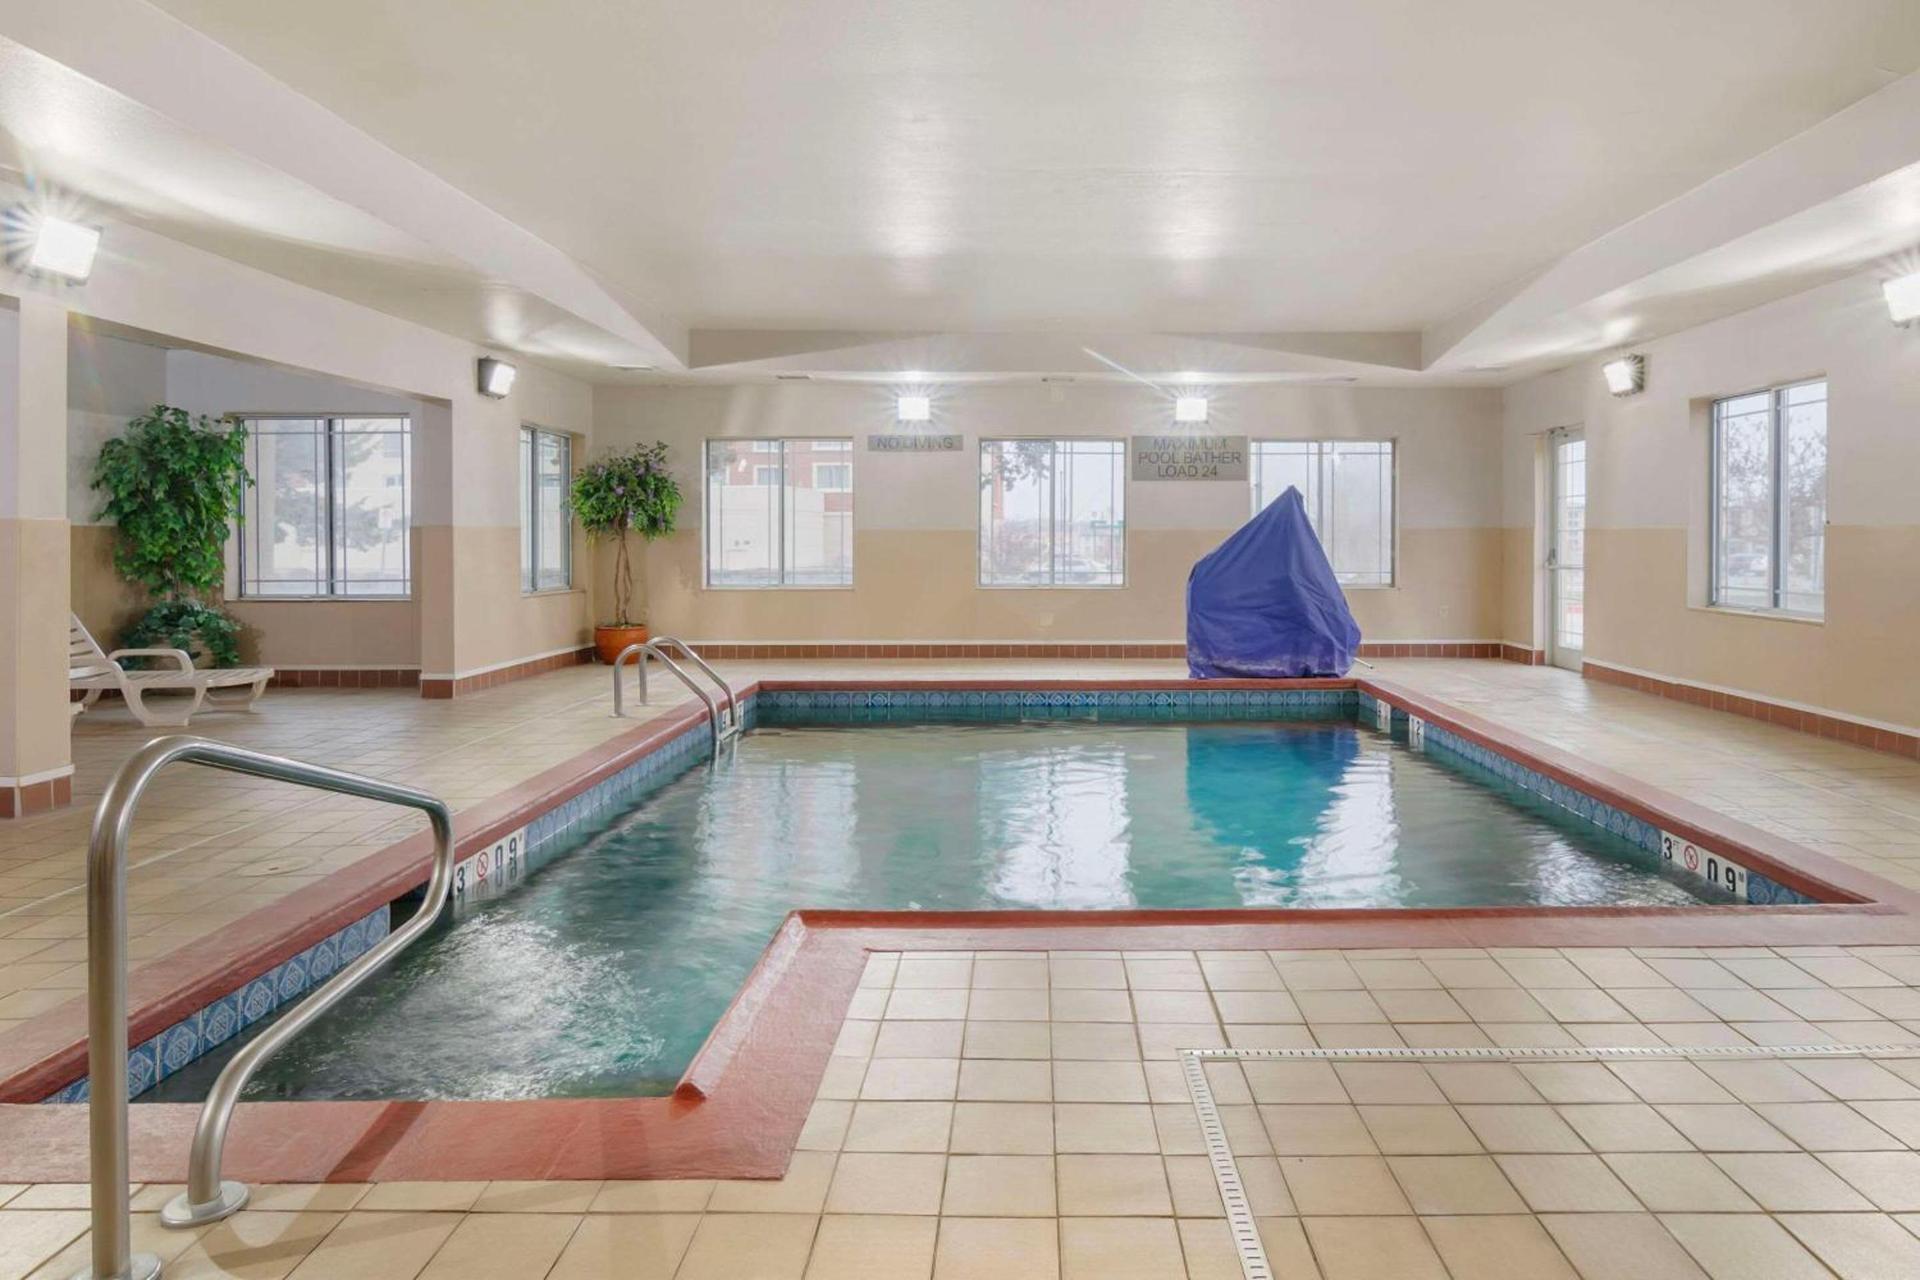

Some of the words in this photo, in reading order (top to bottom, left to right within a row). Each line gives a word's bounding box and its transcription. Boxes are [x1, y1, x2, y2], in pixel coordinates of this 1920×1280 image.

[876, 437, 900, 449] NO
[1138, 451, 1181, 464] POOL
[1183, 451, 1242, 464] BATHER
[1157, 464, 1198, 477] LOAD
[1201, 465, 1218, 478] 24
[1663, 836, 1673, 860] 3
[456, 866, 466, 893] 3
